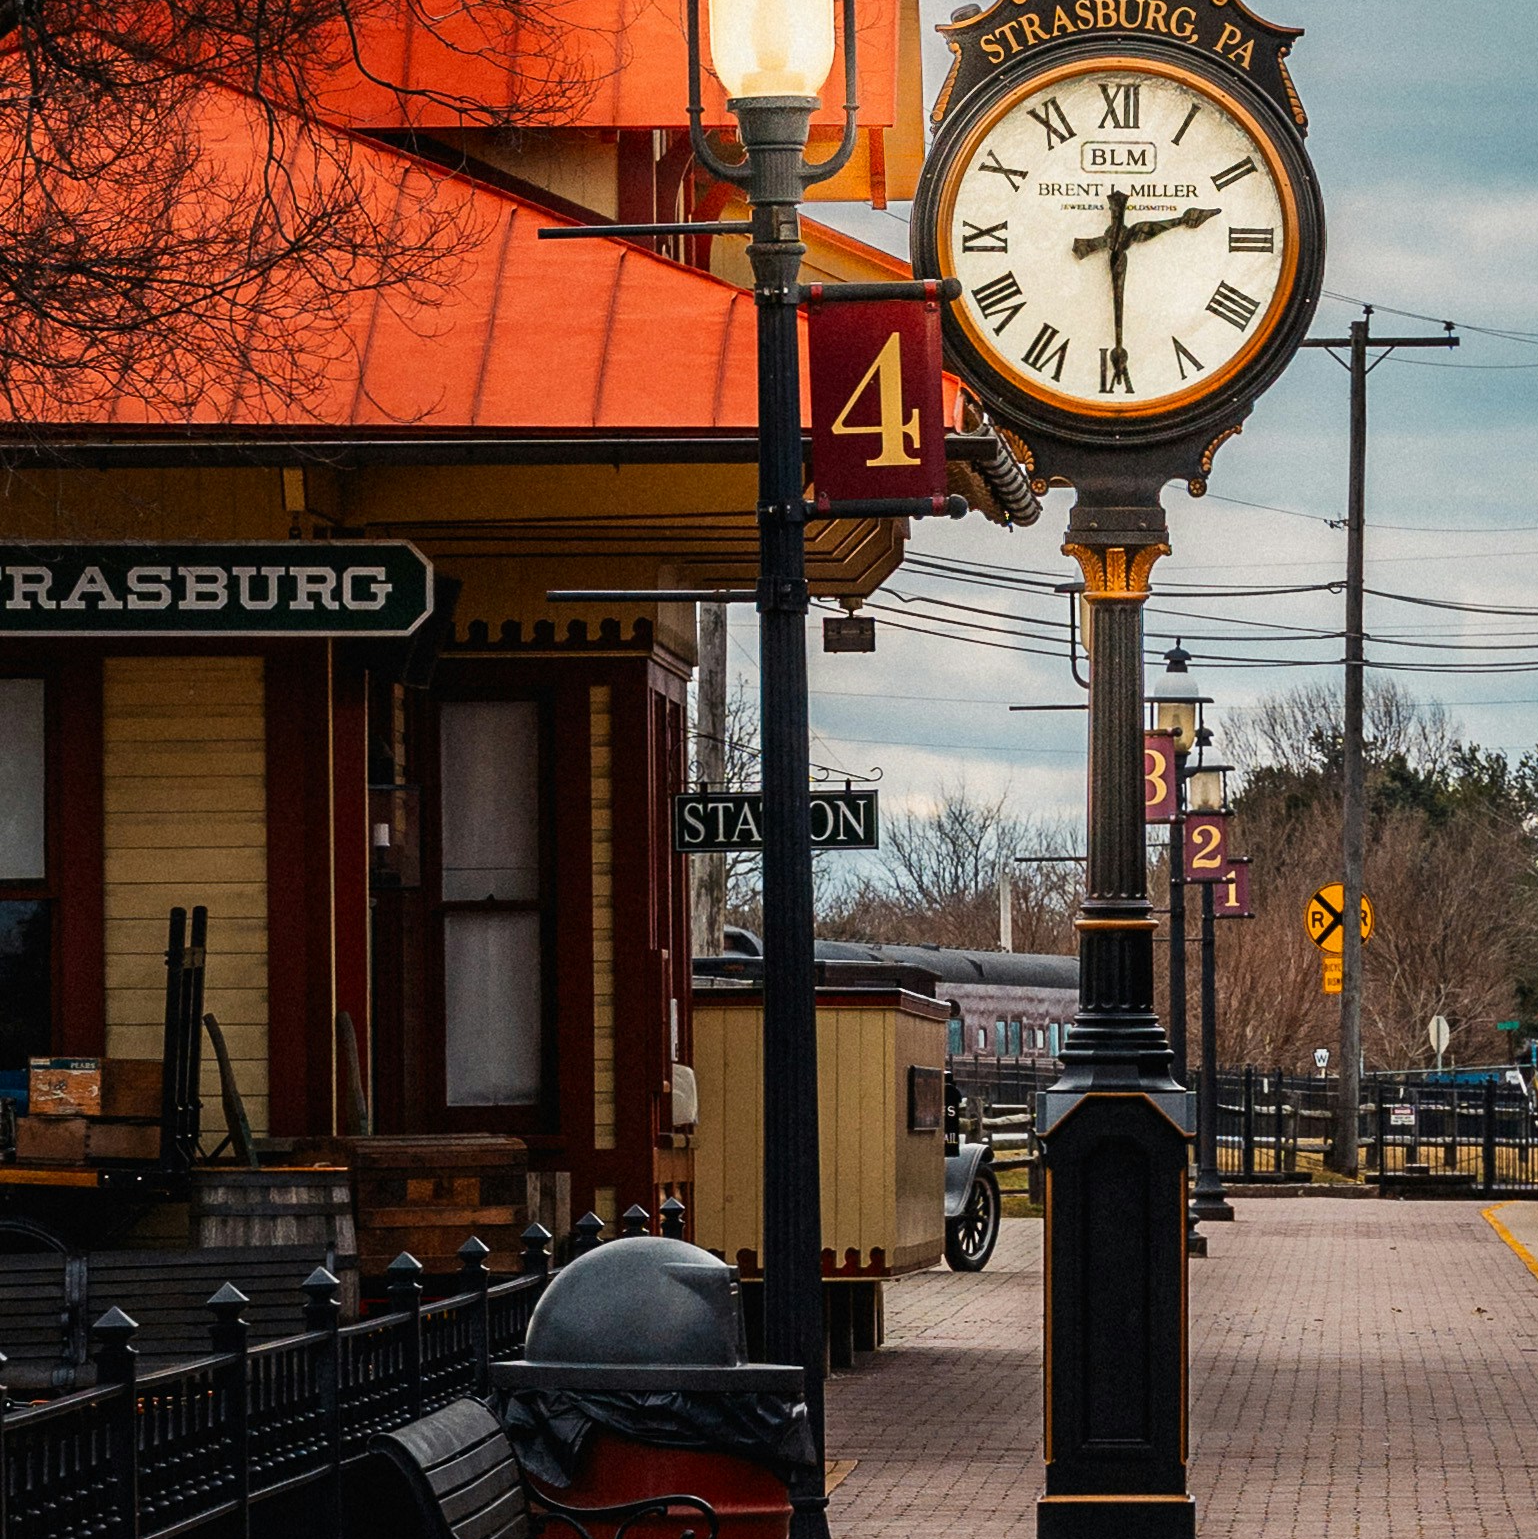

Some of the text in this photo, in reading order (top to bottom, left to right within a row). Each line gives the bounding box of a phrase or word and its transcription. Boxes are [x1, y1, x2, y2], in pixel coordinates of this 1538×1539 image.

[1212, 22, 1256, 71] PA
[1027, 96, 1077, 150] XI
[1098, 84, 1141, 129] XII
[1171, 103, 1201, 146] I
[978, 149, 1028, 192] X
[1090, 148, 1147, 166] BLM
[1210, 156, 1258, 191] II
[1038, 183, 1103, 196] BRENT
[1129, 184, 1199, 198] MILLER
[1060, 203, 1104, 211] JEWELERS
[963, 220, 1008, 253] IX
[1229, 227, 1274, 253] III
[971, 271, 1027, 336] VIII
[1205, 280, 1260, 332] IIII
[1021, 323, 1070, 382] VII
[1171, 336, 1205, 380] V
[831, 331, 921, 467] 4
[0, 566, 393, 610] RASBURG
[683, 800, 867, 843] STAON
[1192, 825, 1222, 869] 2
[1225, 870, 1240, 907] 1
[1311, 911, 1324, 928] R
[946, 1106, 956, 1117] S
